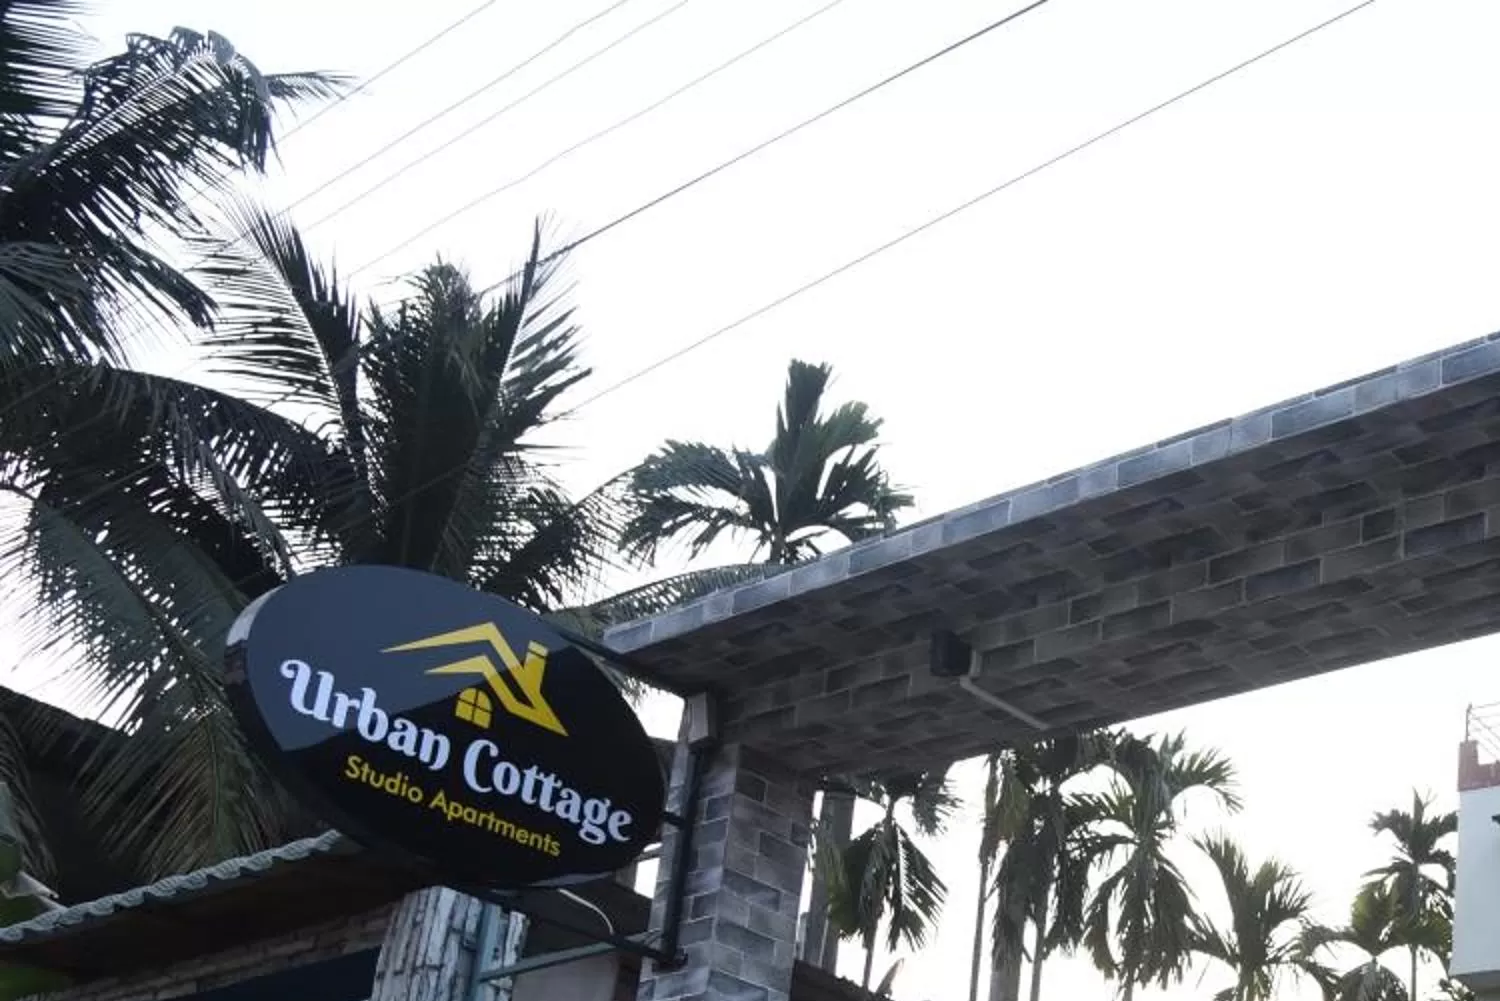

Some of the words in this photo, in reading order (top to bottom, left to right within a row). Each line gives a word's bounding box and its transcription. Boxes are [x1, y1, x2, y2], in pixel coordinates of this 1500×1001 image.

[280, 659, 450, 772] Urban
[463, 739, 632, 845] Cottage
[345, 755, 424, 803] Studio
[429, 788, 561, 857] Apartments
